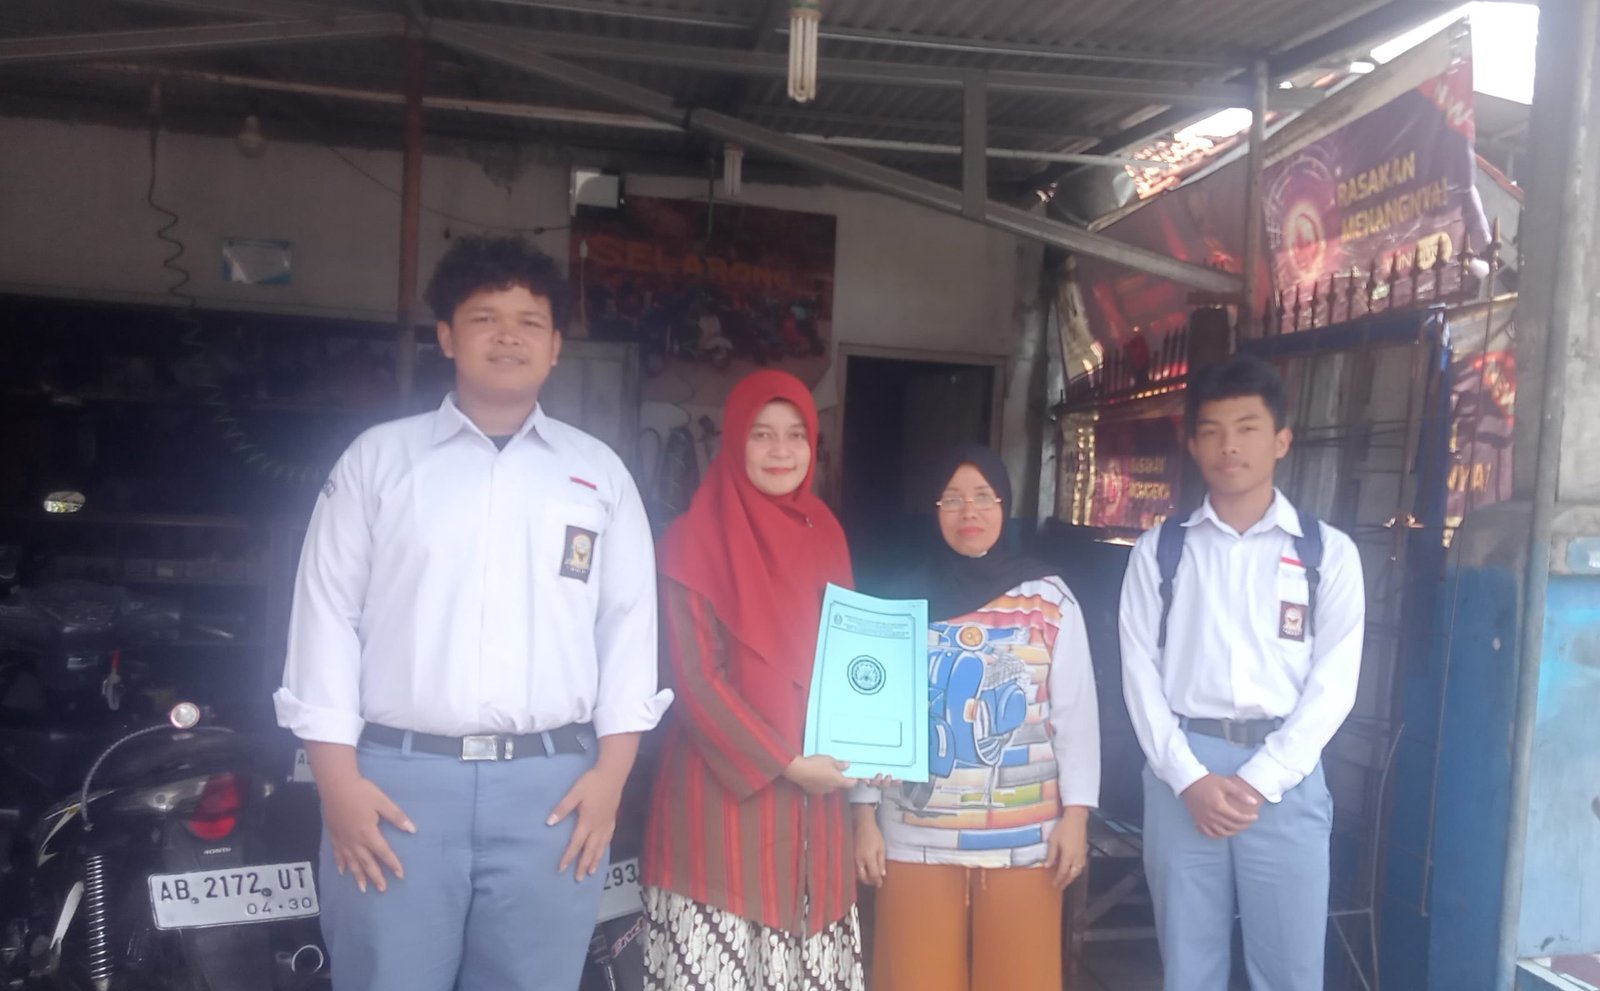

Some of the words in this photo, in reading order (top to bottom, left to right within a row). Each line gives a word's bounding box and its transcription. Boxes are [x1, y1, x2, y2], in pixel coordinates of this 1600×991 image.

[1337, 151, 1416, 207] RASAKAN
[160, 880, 190, 902] AB
[204, 872, 261, 898] 2172
[277, 867, 306, 890] UT
